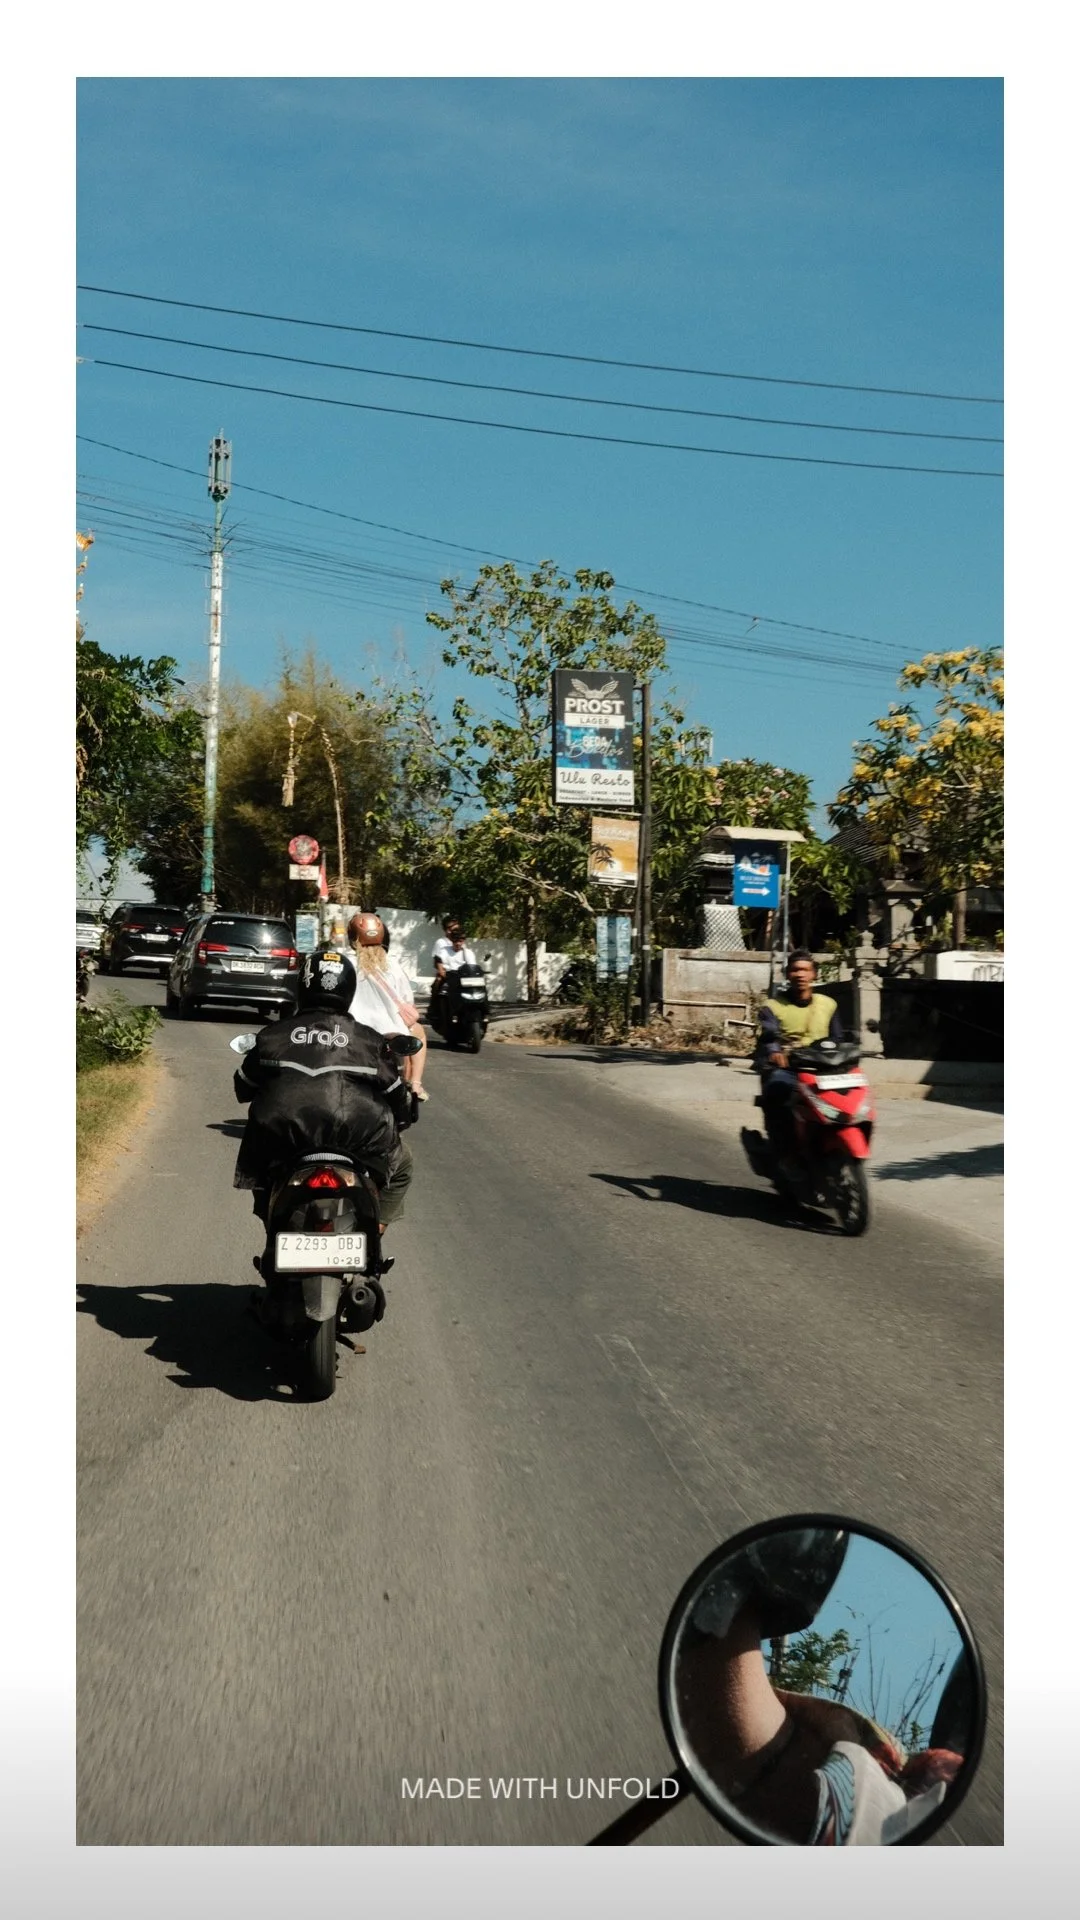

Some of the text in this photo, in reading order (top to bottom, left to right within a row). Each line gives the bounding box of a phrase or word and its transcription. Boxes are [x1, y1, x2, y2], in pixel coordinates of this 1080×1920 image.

[565, 698, 625, 714] PROST
[580, 716, 610, 724] LAGER
[560, 771, 631, 786] Ulu Resto
[290, 1024, 349, 1047] Grab
[281, 1237, 362, 1251] Z 2293 DBJ
